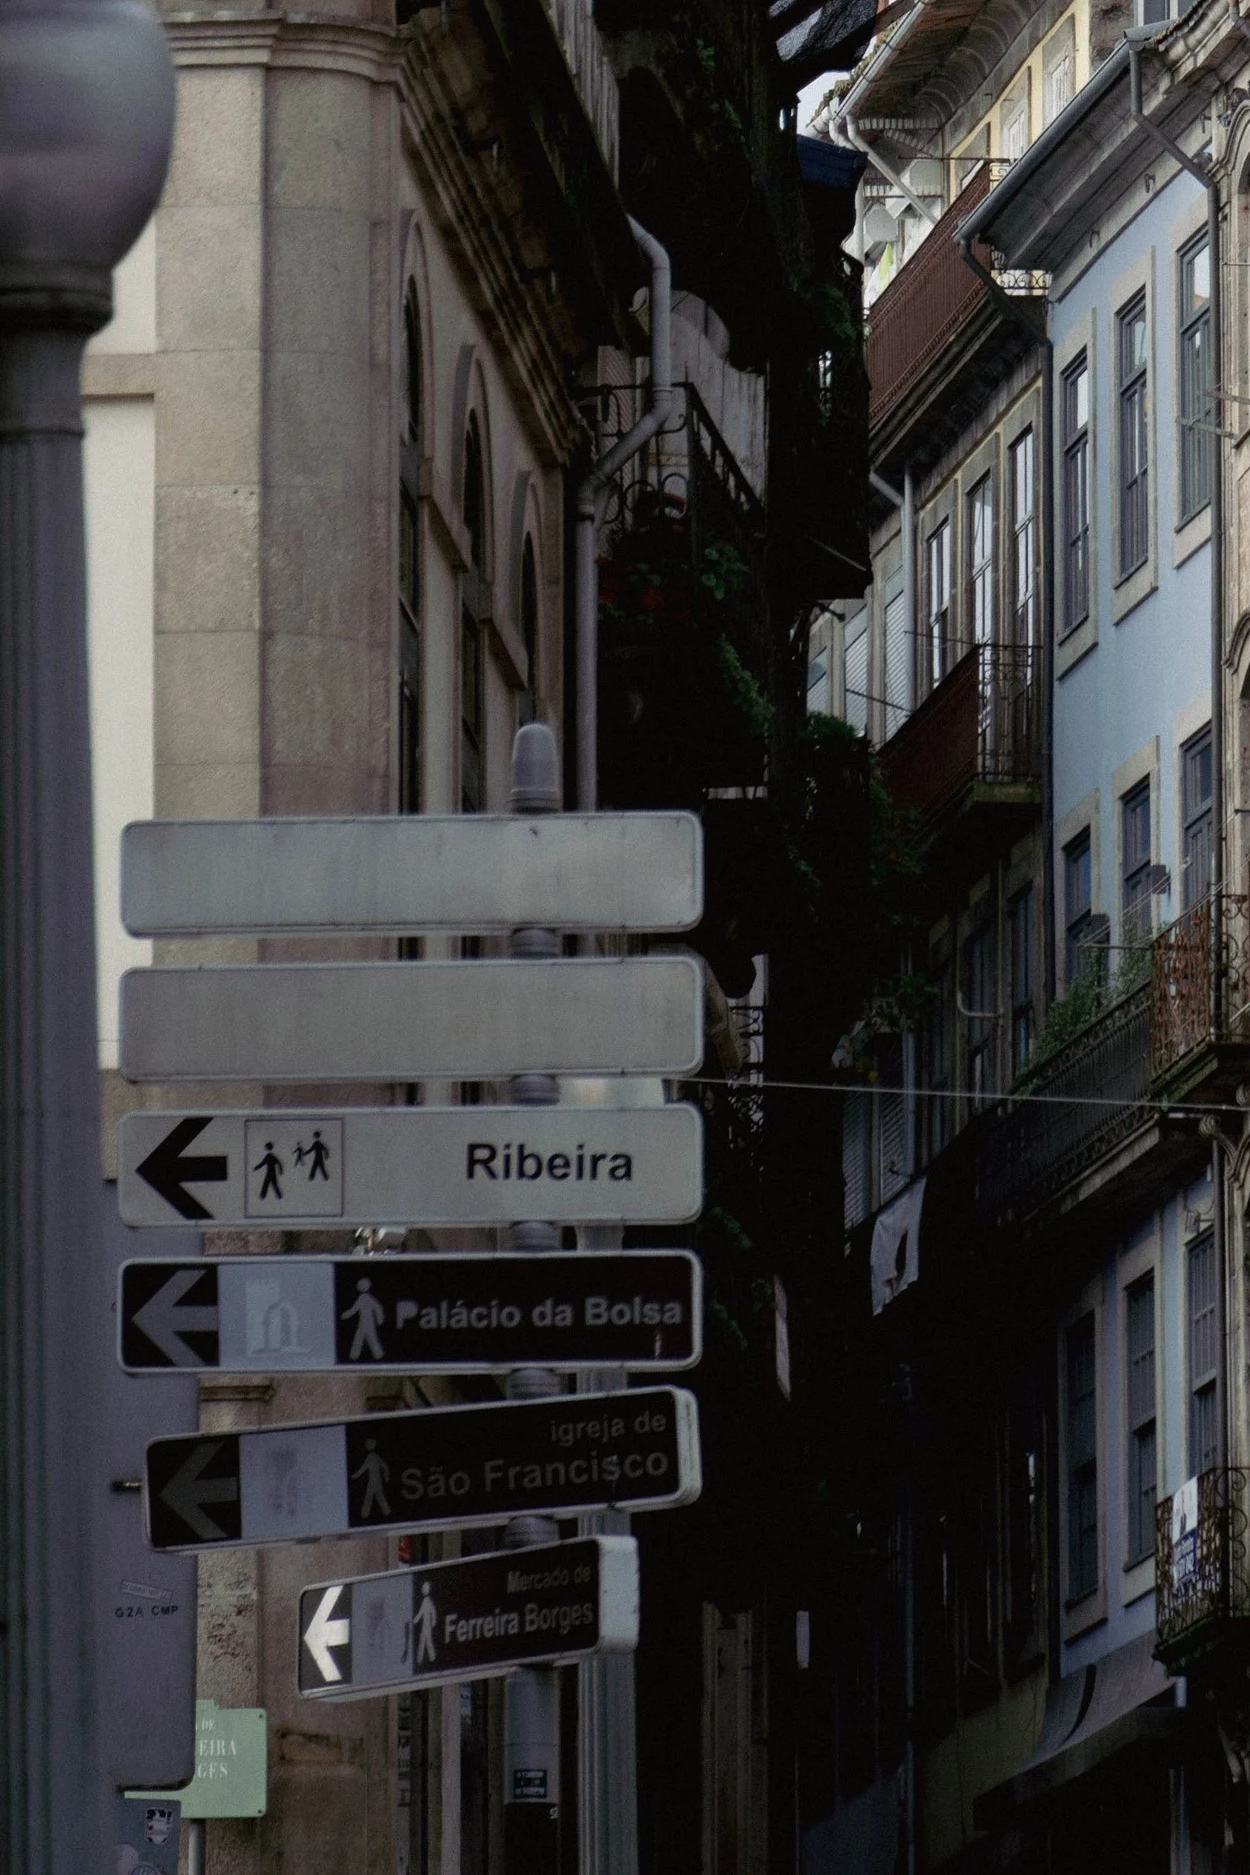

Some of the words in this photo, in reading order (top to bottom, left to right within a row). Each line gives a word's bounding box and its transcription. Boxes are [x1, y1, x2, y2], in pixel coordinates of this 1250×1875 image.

[467, 1143, 633, 1181] Ribeira
[396, 1297, 522, 1330] Palácio
[531, 1297, 575, 1328] da
[585, 1294, 684, 1326] Bolsa
[551, 1414, 625, 1447] igreja
[633, 1409, 667, 1434] de
[401, 1464, 471, 1500] São
[484, 1449, 669, 1493] Francisco
[507, 1565, 570, 1594] Mercado
[574, 1563, 592, 1584] de
[151, 1605, 178, 1616] CMP
[444, 1608, 520, 1645] Ferreira
[524, 1601, 593, 1635] Borges
[201, 1719, 215, 1731] DE
[200, 1738, 236, 1756] EIRA
[197, 1762, 228, 1778] GES
